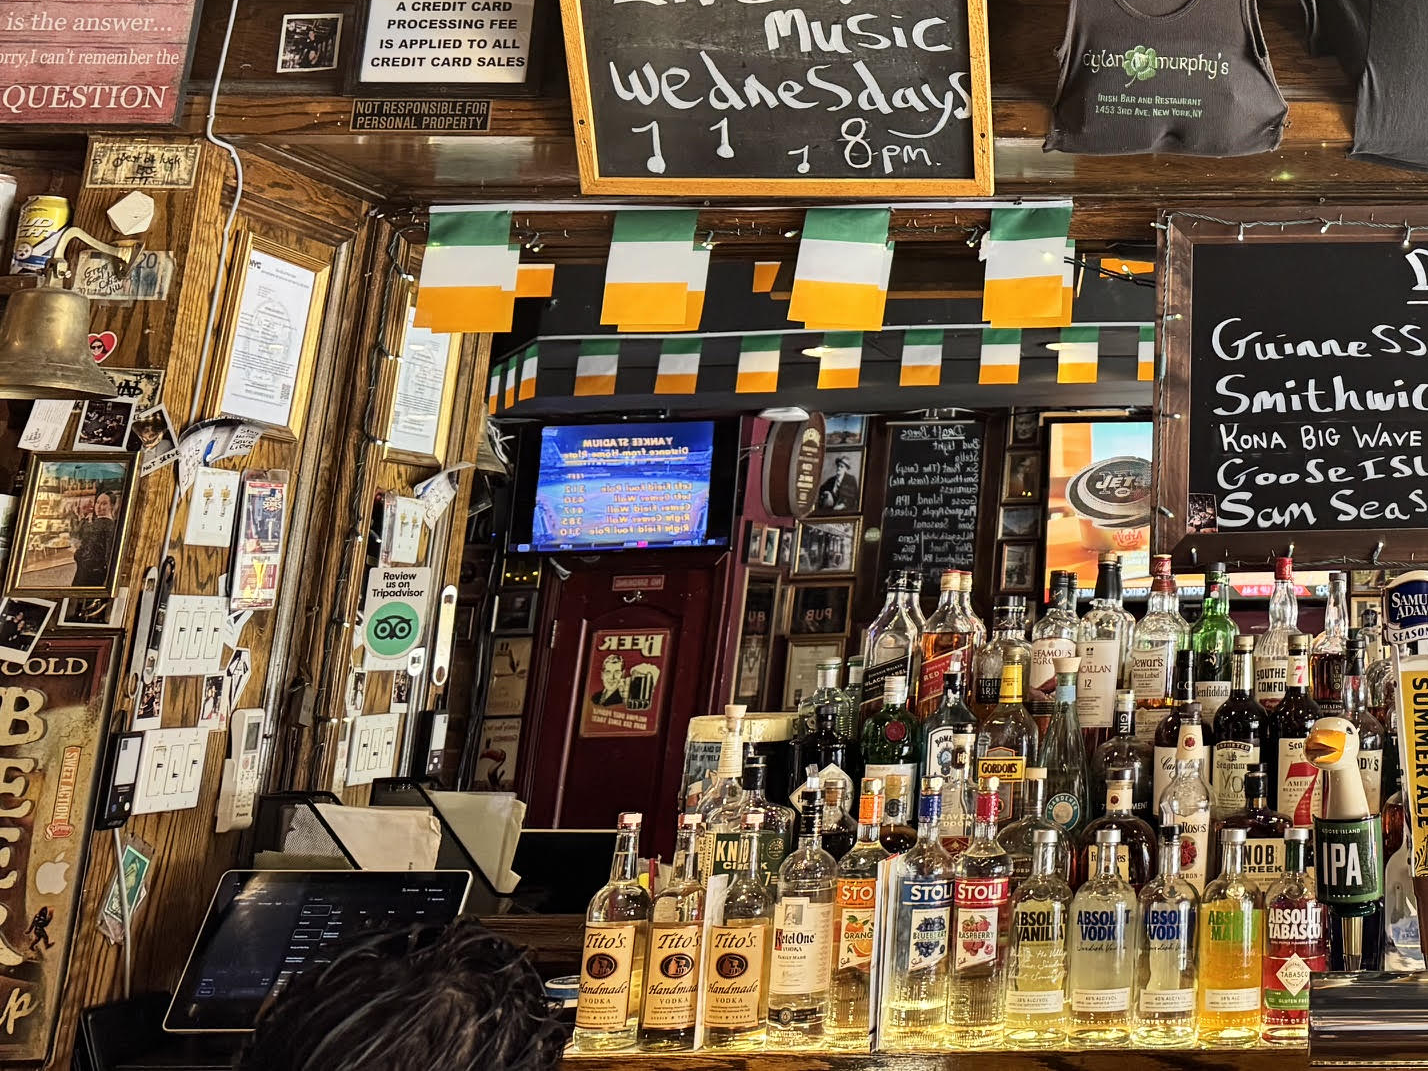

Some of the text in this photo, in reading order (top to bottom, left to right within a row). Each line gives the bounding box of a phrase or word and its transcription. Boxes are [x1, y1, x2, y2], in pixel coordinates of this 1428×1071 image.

[396, 1, 513, 12] A CREDIT CARD
[6, 11, 172, 32] is the answer...
[387, 19, 518, 30] PROCESSING FEE
[764, 7, 953, 53] Music
[379, 39, 520, 49] IS APPLIED TO ALL
[40, 48, 180, 65] can't remember the
[370, 57, 525, 67] CREDIT CARD SALES
[2, 85, 169, 113] QUESTION
[1097, 93, 1202, 106] IRISH BAR AND RESTAURANT
[355, 101, 488, 115] NOT RESPONSIBLE FOR
[1152, 107, 1170, 117] NEW
[356, 116, 484, 129] PERSONAL PROPERTY
[1211, 317, 1428, 361] Guinness
[1219, 422, 1423, 453] KONA BIG WAVE
[1217, 457, 1355, 491] Goose
[1216, 490, 1317, 529] Sam
[383, 572, 417, 580] Review
[372, 589, 424, 599] Tripadvisor
[1, 657, 89, 676] COLD
[923, 668, 941, 682] RED
[1084, 679, 1092, 690] 12
[1119, 713, 1128, 734] GIN
[64, 749, 81, 781] SWEET
[980, 761, 1018, 775] GORDON'S
[55, 783, 76, 821] ACTION
[1182, 822, 1207, 833] Roses
[1323, 841, 1364, 887] IPA
[957, 884, 1000, 900] STOLI
[1267, 907, 1322, 925] ABSOLUT
[775, 929, 815, 946] Ketel One
[958, 930, 995, 940] RASPBERRY
[1268, 923, 1322, 940] TABASCO
[585, 932, 627, 948] Tito's
[657, 931, 702, 949] Tito's
[714, 932, 757, 948] Tito's
[1280, 971, 1309, 979] TABASCO
[578, 981, 628, 995] Handmade
[707, 979, 759, 995] Handmade
[584, 997, 612, 1005] VODKA
[659, 997, 690, 1005] VODKA
[716, 997, 744, 1005] VODKA
